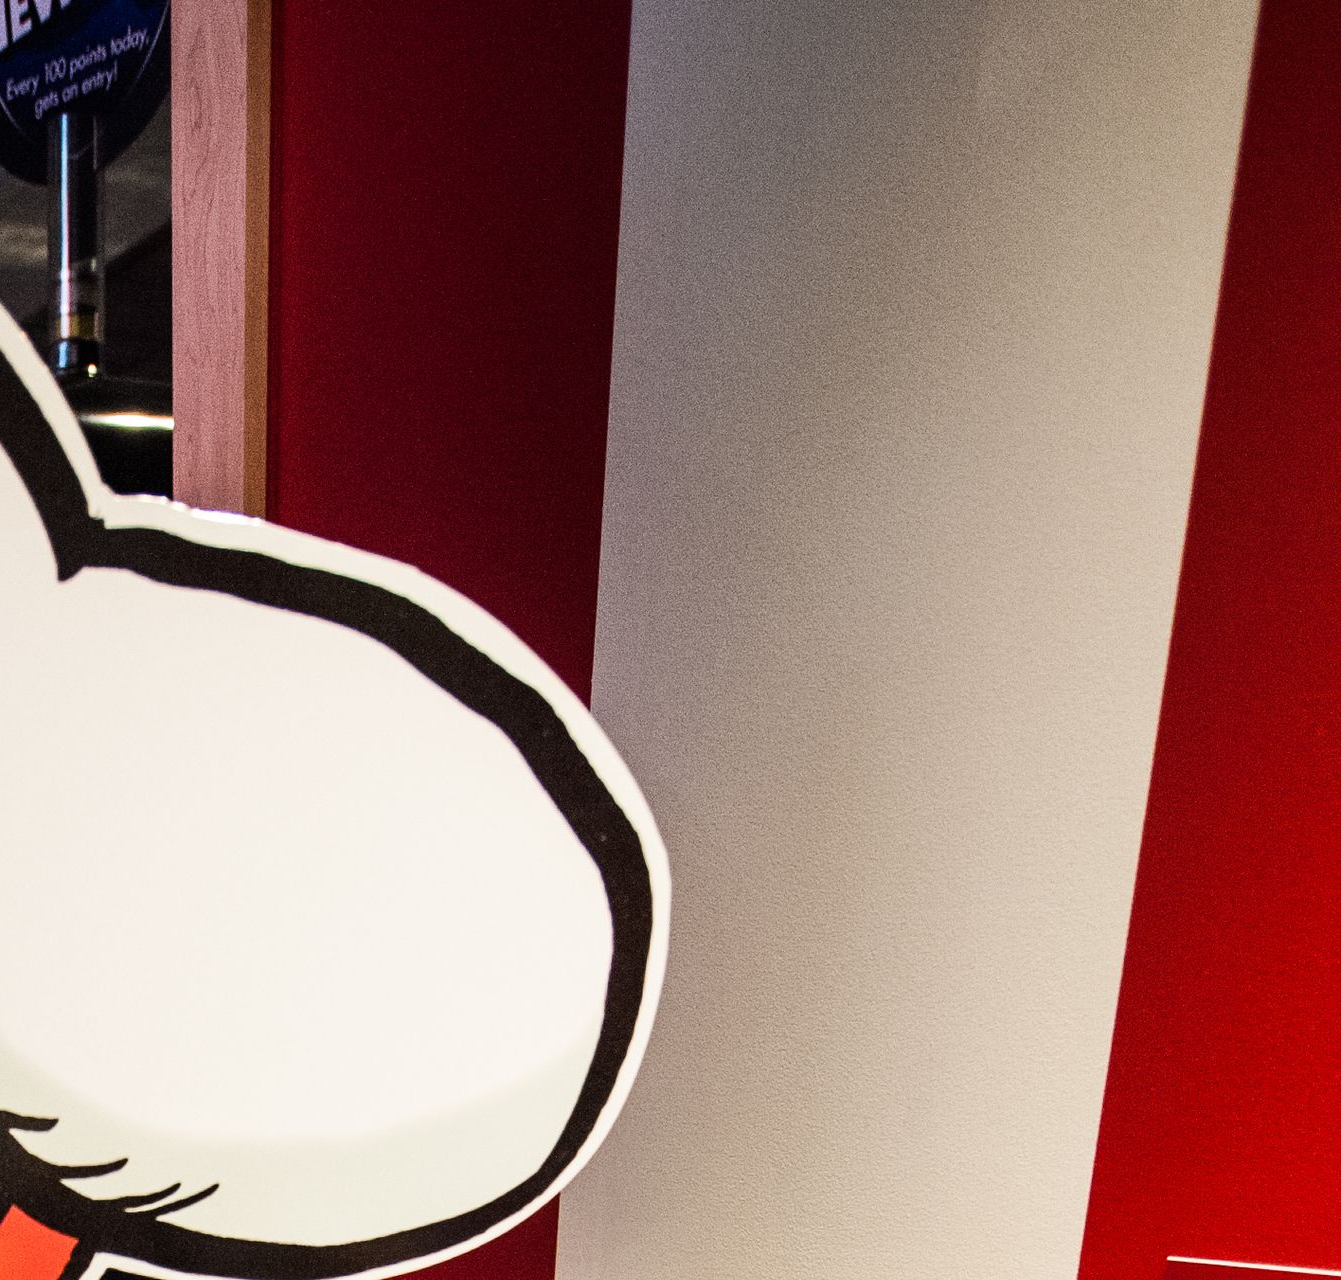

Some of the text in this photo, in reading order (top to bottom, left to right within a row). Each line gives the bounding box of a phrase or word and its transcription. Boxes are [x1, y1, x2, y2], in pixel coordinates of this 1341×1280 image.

[5, 25, 149, 101] Every 100 points today,
[34, 61, 118, 120] gets an entry!
